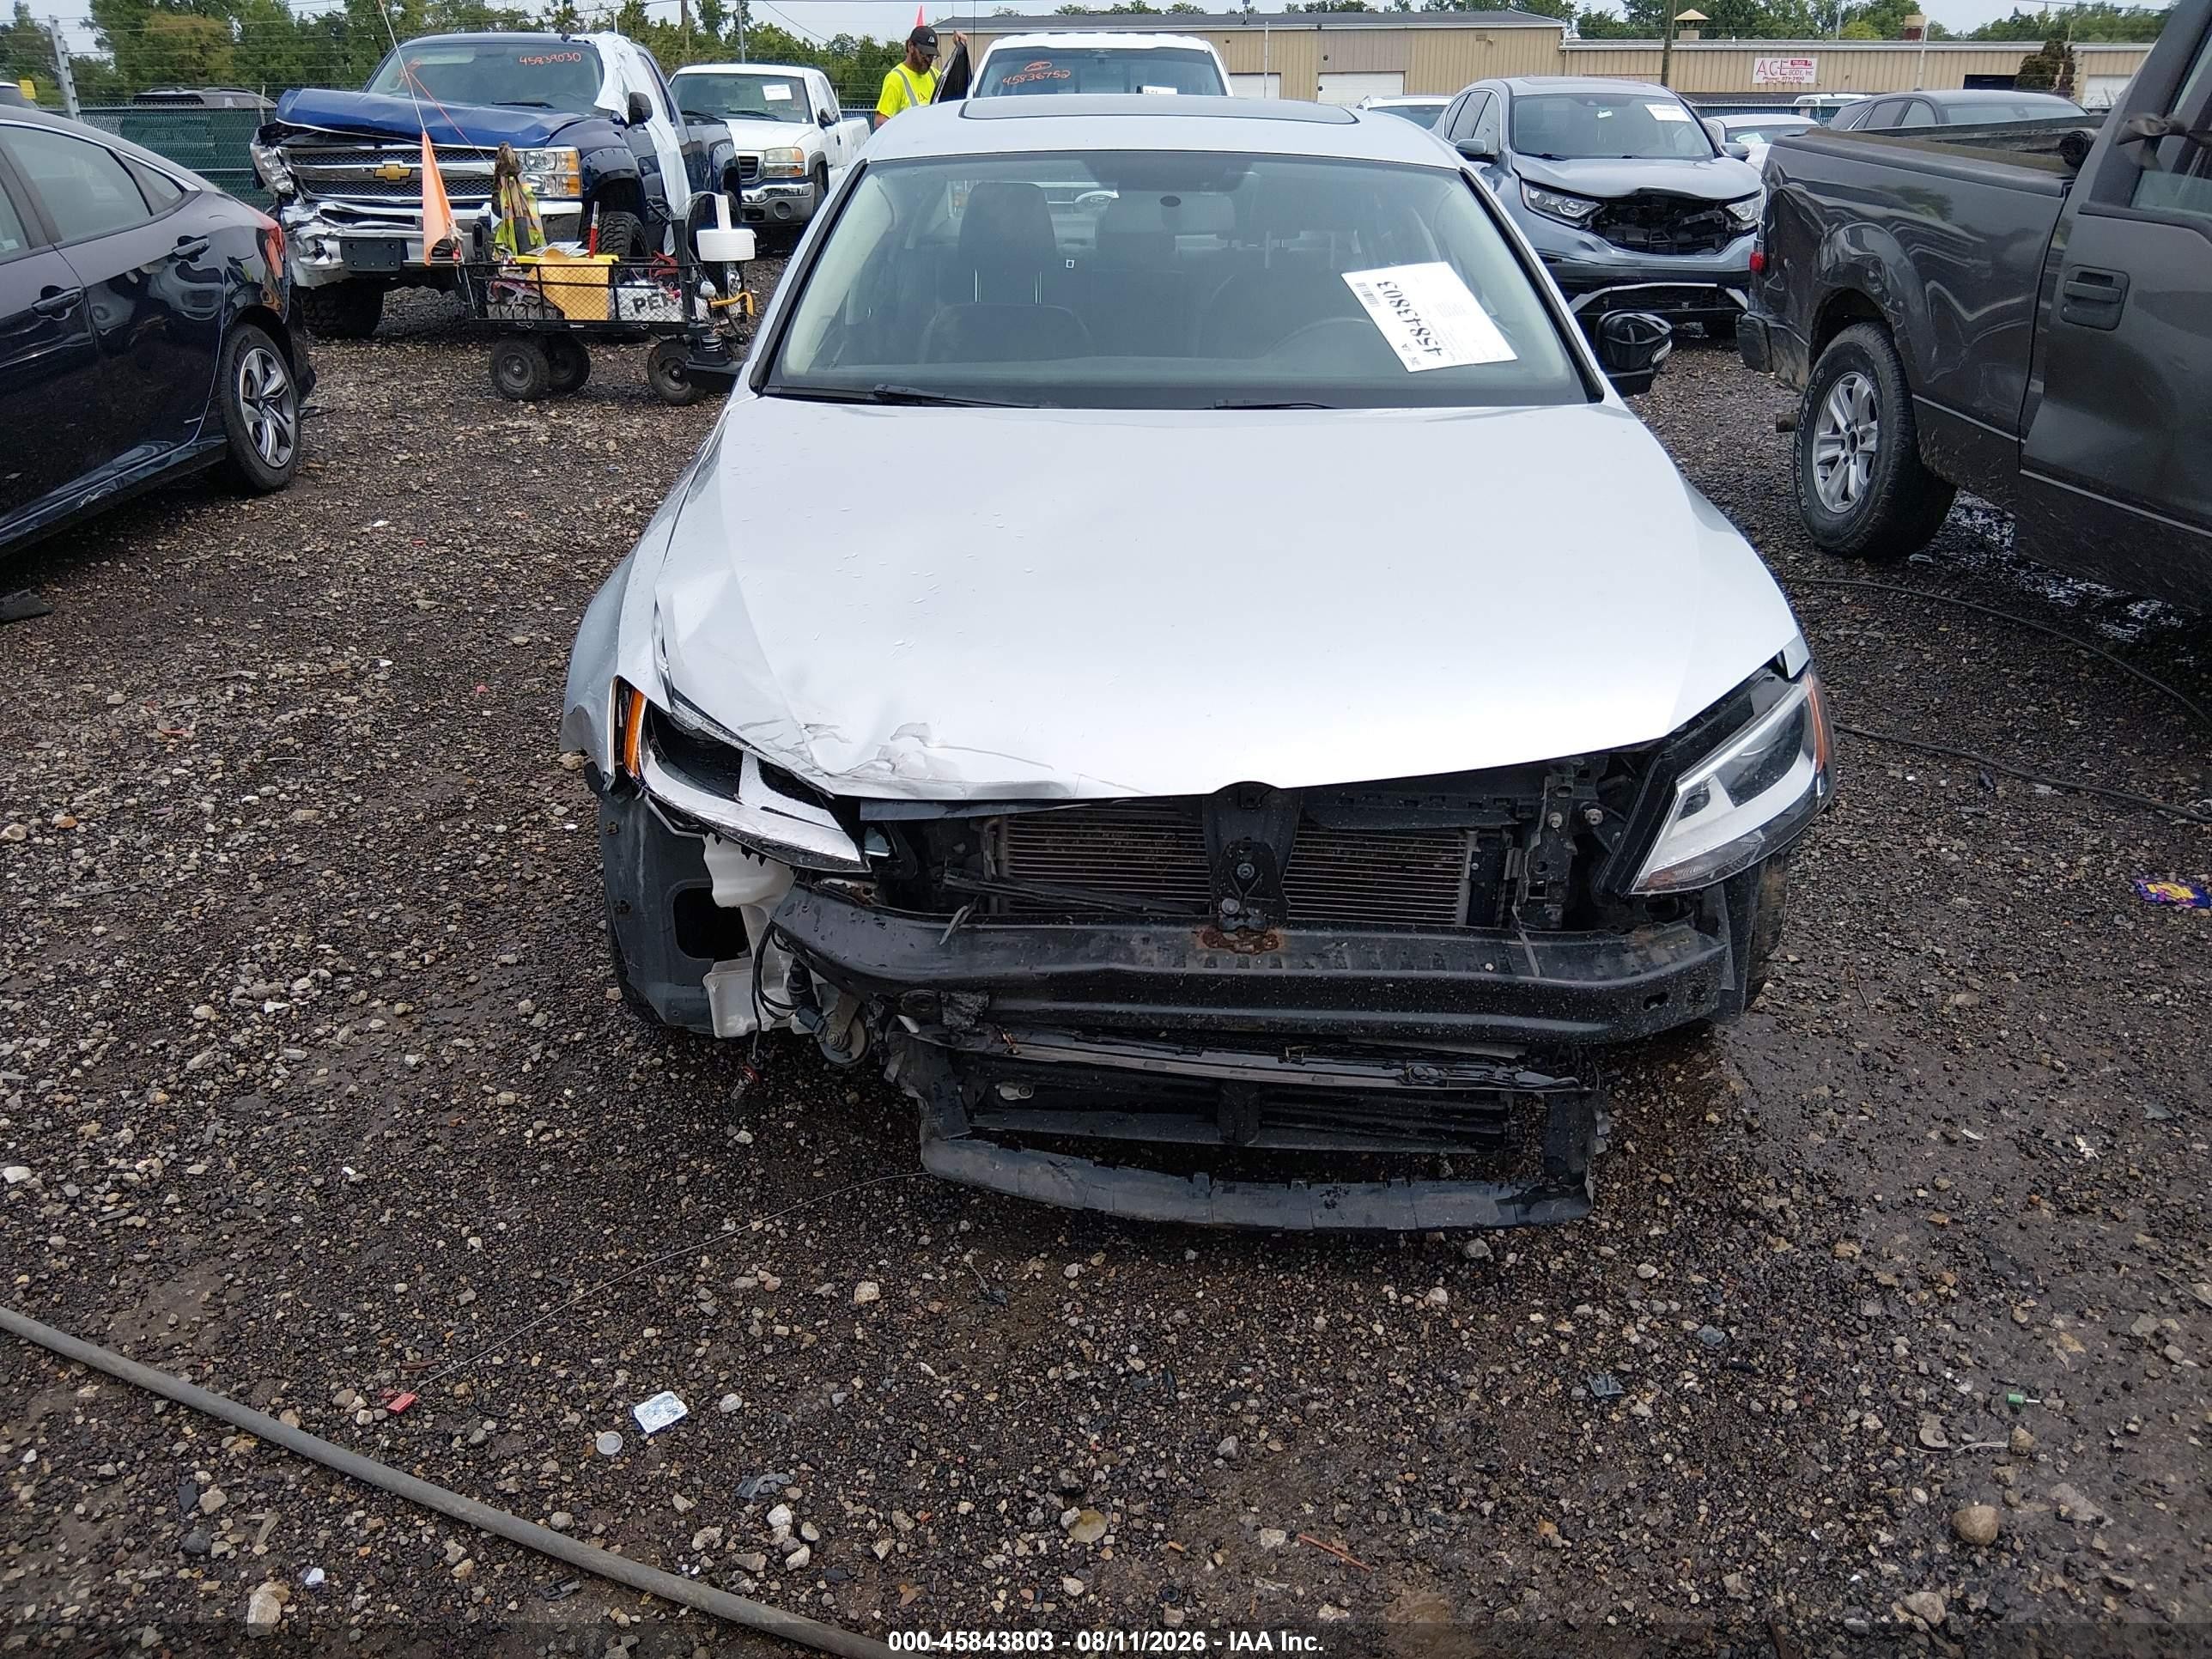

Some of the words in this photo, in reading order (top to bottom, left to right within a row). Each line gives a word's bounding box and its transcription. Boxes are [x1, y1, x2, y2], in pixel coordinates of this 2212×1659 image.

[519, 52, 581, 66] 45839030
[1756, 59, 1788, 76] ACE
[1002, 70, 1071, 86] 45836752
[1376, 281, 1443, 356] 45843803
[1794, 367, 1826, 511] GOODYEAR
